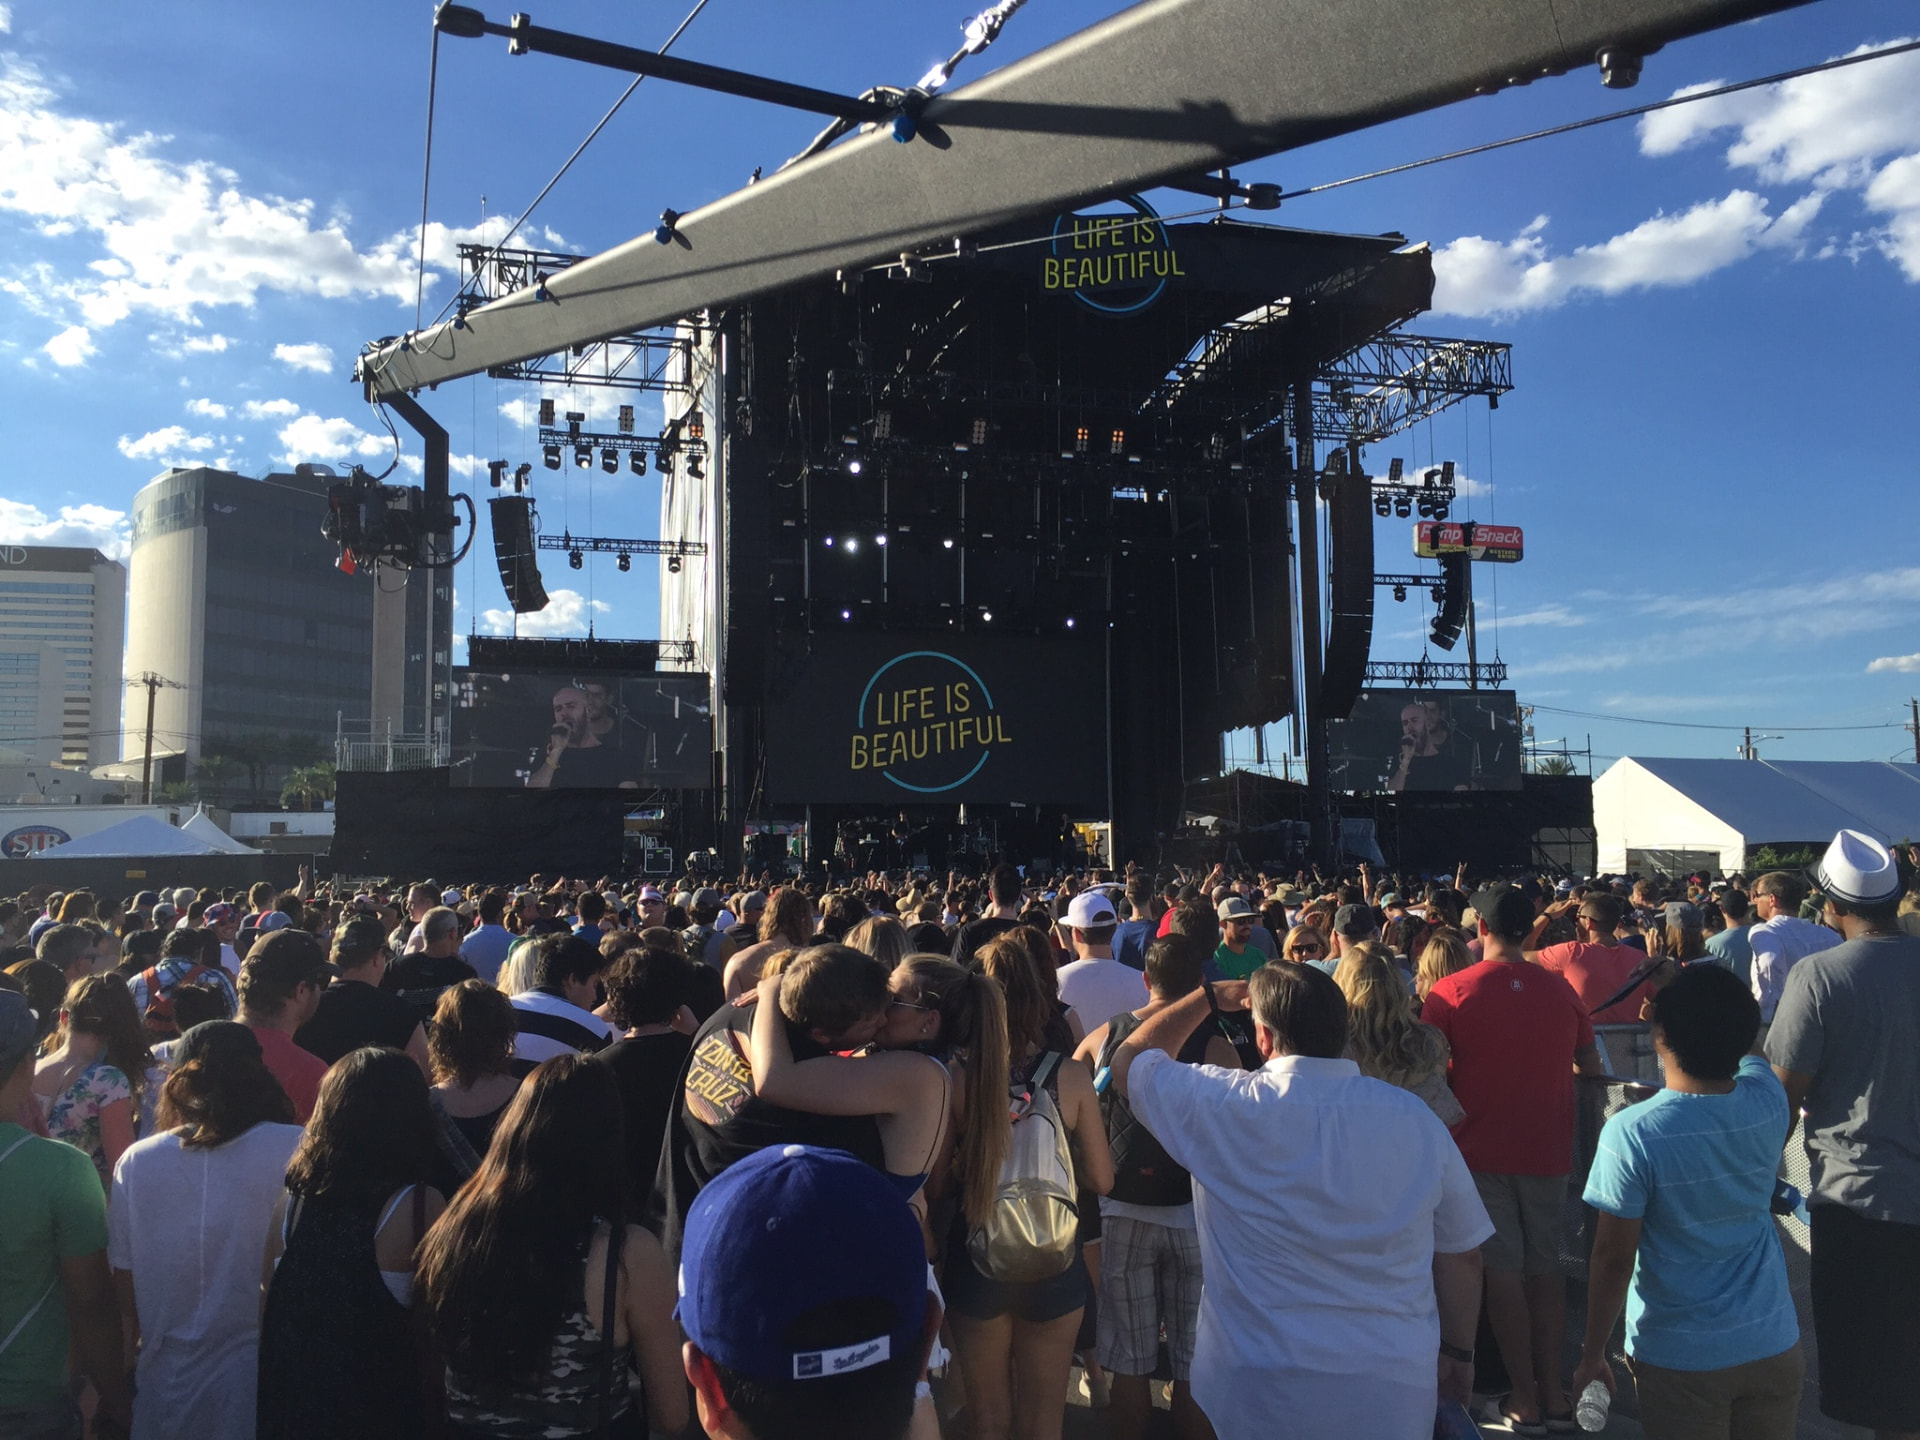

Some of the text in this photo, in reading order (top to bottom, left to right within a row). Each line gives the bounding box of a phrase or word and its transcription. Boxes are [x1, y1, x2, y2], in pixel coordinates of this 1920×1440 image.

[1074, 216, 1155, 249] LIFE IS
[1044, 250, 1186, 289] BEAUTIFUL
[1420, 524, 1461, 543] Pmp
[1476, 528, 1521, 544] Snack
[877, 682, 970, 726] LIFE IS
[851, 715, 1012, 770] BEAUTIFUL
[685, 1066, 739, 1108] CRUZ
